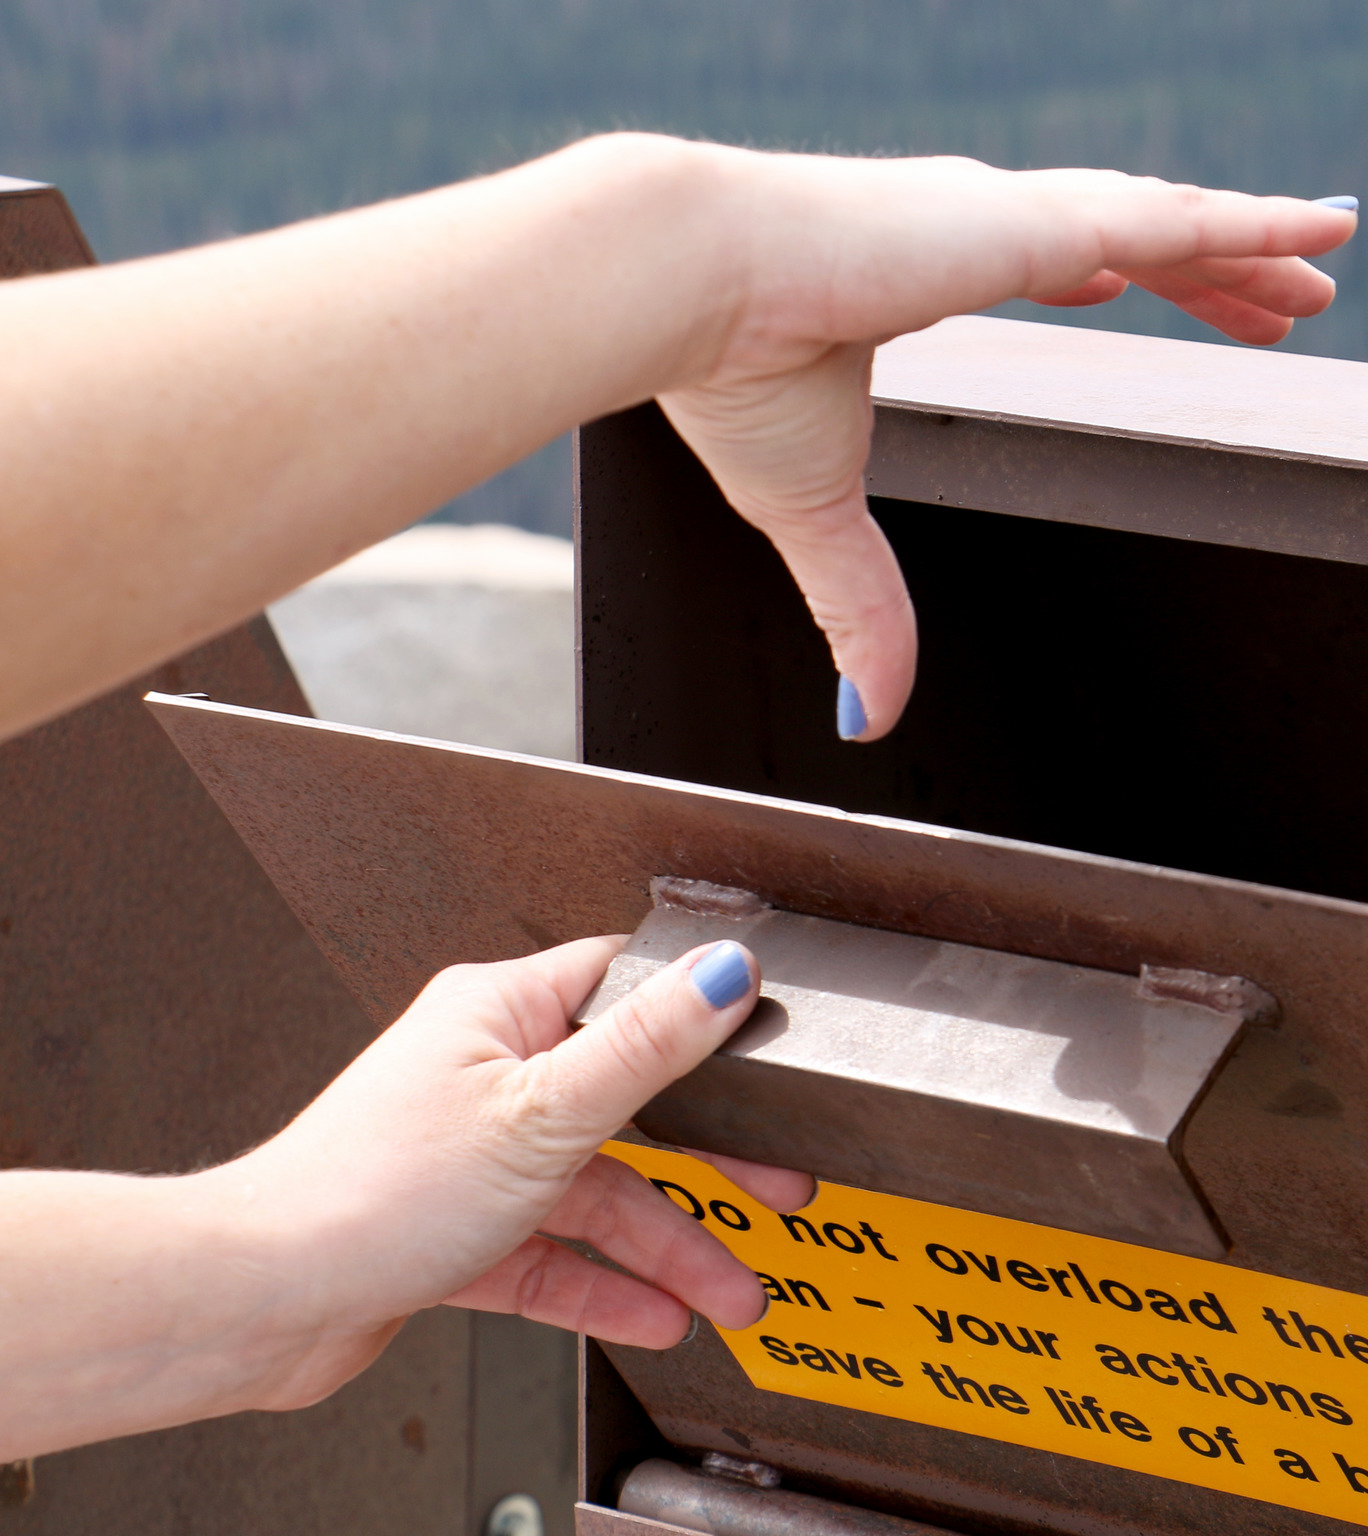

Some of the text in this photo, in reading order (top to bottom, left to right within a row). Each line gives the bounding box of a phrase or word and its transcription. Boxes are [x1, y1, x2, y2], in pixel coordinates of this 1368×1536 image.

[648, 1176, 751, 1232] Do
[777, 1212, 899, 1262] not
[924, 1242, 1238, 1334] overload
[754, 1271, 832, 1312] an
[913, 1304, 1061, 1361] your
[1094, 1343, 1354, 1426] actions
[759, 1335, 904, 1388] save
[920, 1361, 1030, 1415] the
[1043, 1386, 1153, 1443] life
[1177, 1425, 1245, 1465] of
[1273, 1448, 1320, 1483] a
